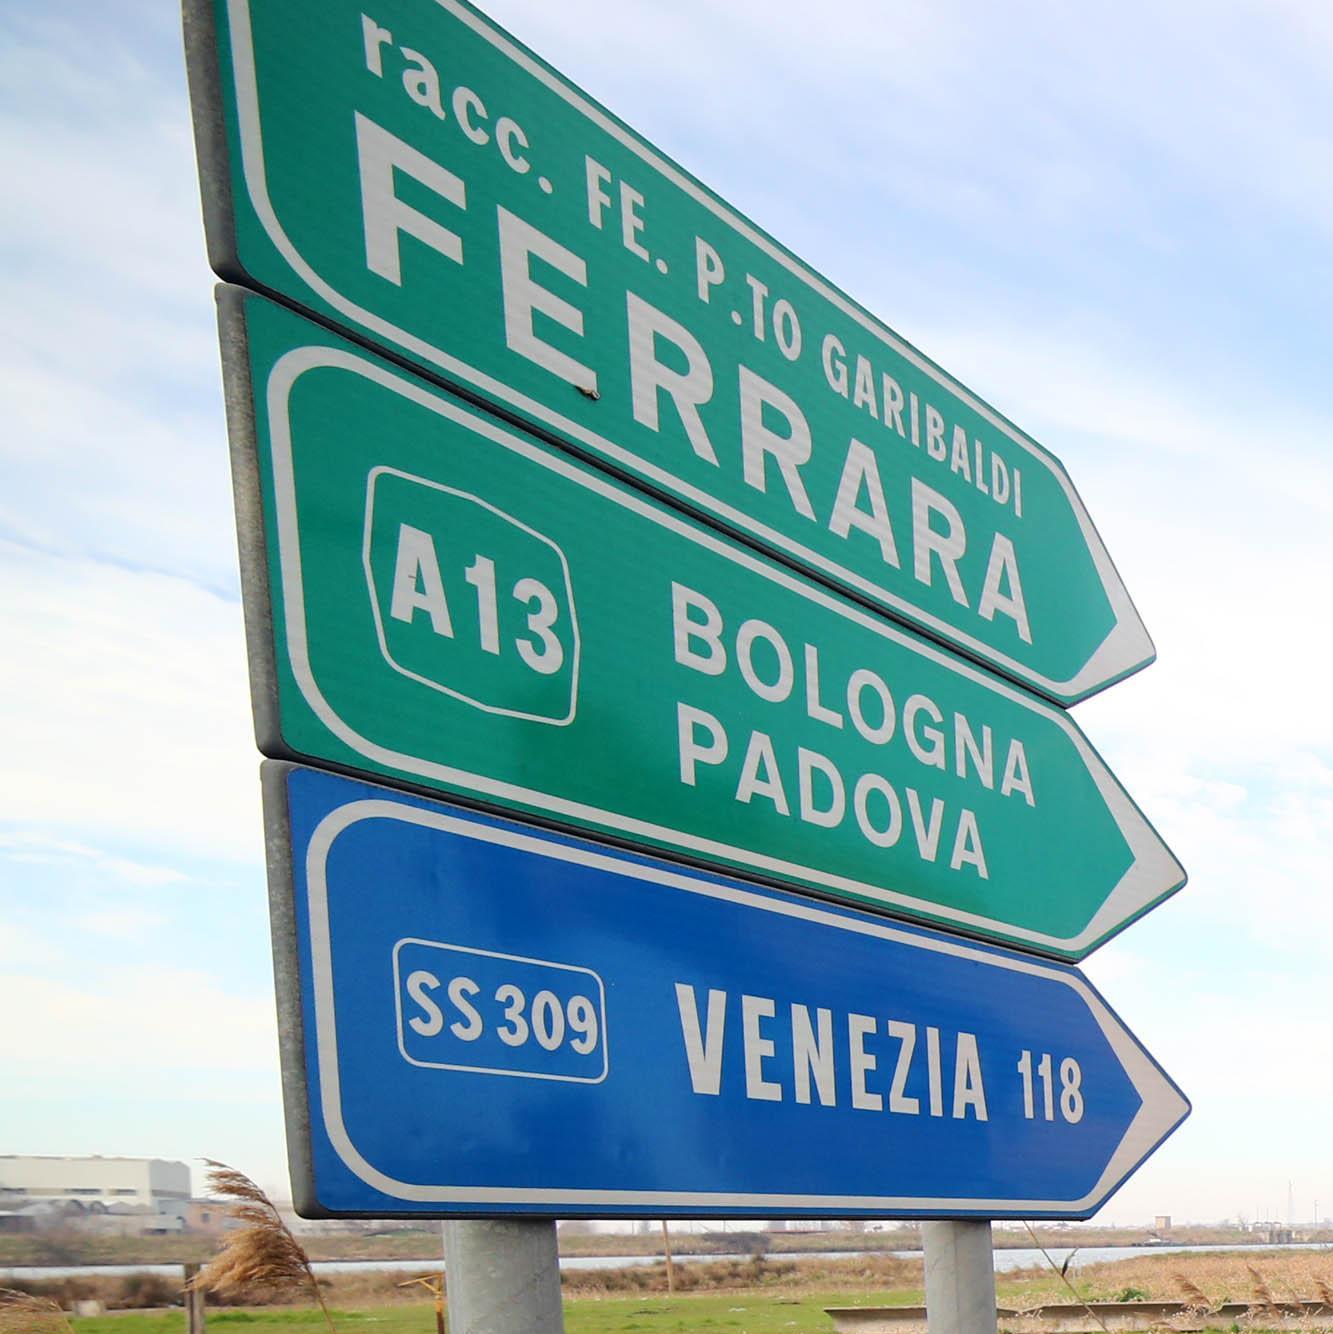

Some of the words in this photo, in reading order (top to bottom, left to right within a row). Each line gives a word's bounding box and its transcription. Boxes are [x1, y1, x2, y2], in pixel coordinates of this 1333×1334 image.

[361, 12, 553, 195] racc.
[584, 154, 669, 276] FE.
[694, 235, 803, 362] P.TO
[821, 333, 1023, 519] GARIBALDI
[354, 109, 1034, 646] FERRARA
[389, 522, 565, 675] A13
[671, 581, 1036, 808] BOLOGNA
[675, 701, 991, 880] PADOVA
[675, 983, 989, 1122] VENEZIA
[1017, 1049, 1084, 1124] 118
